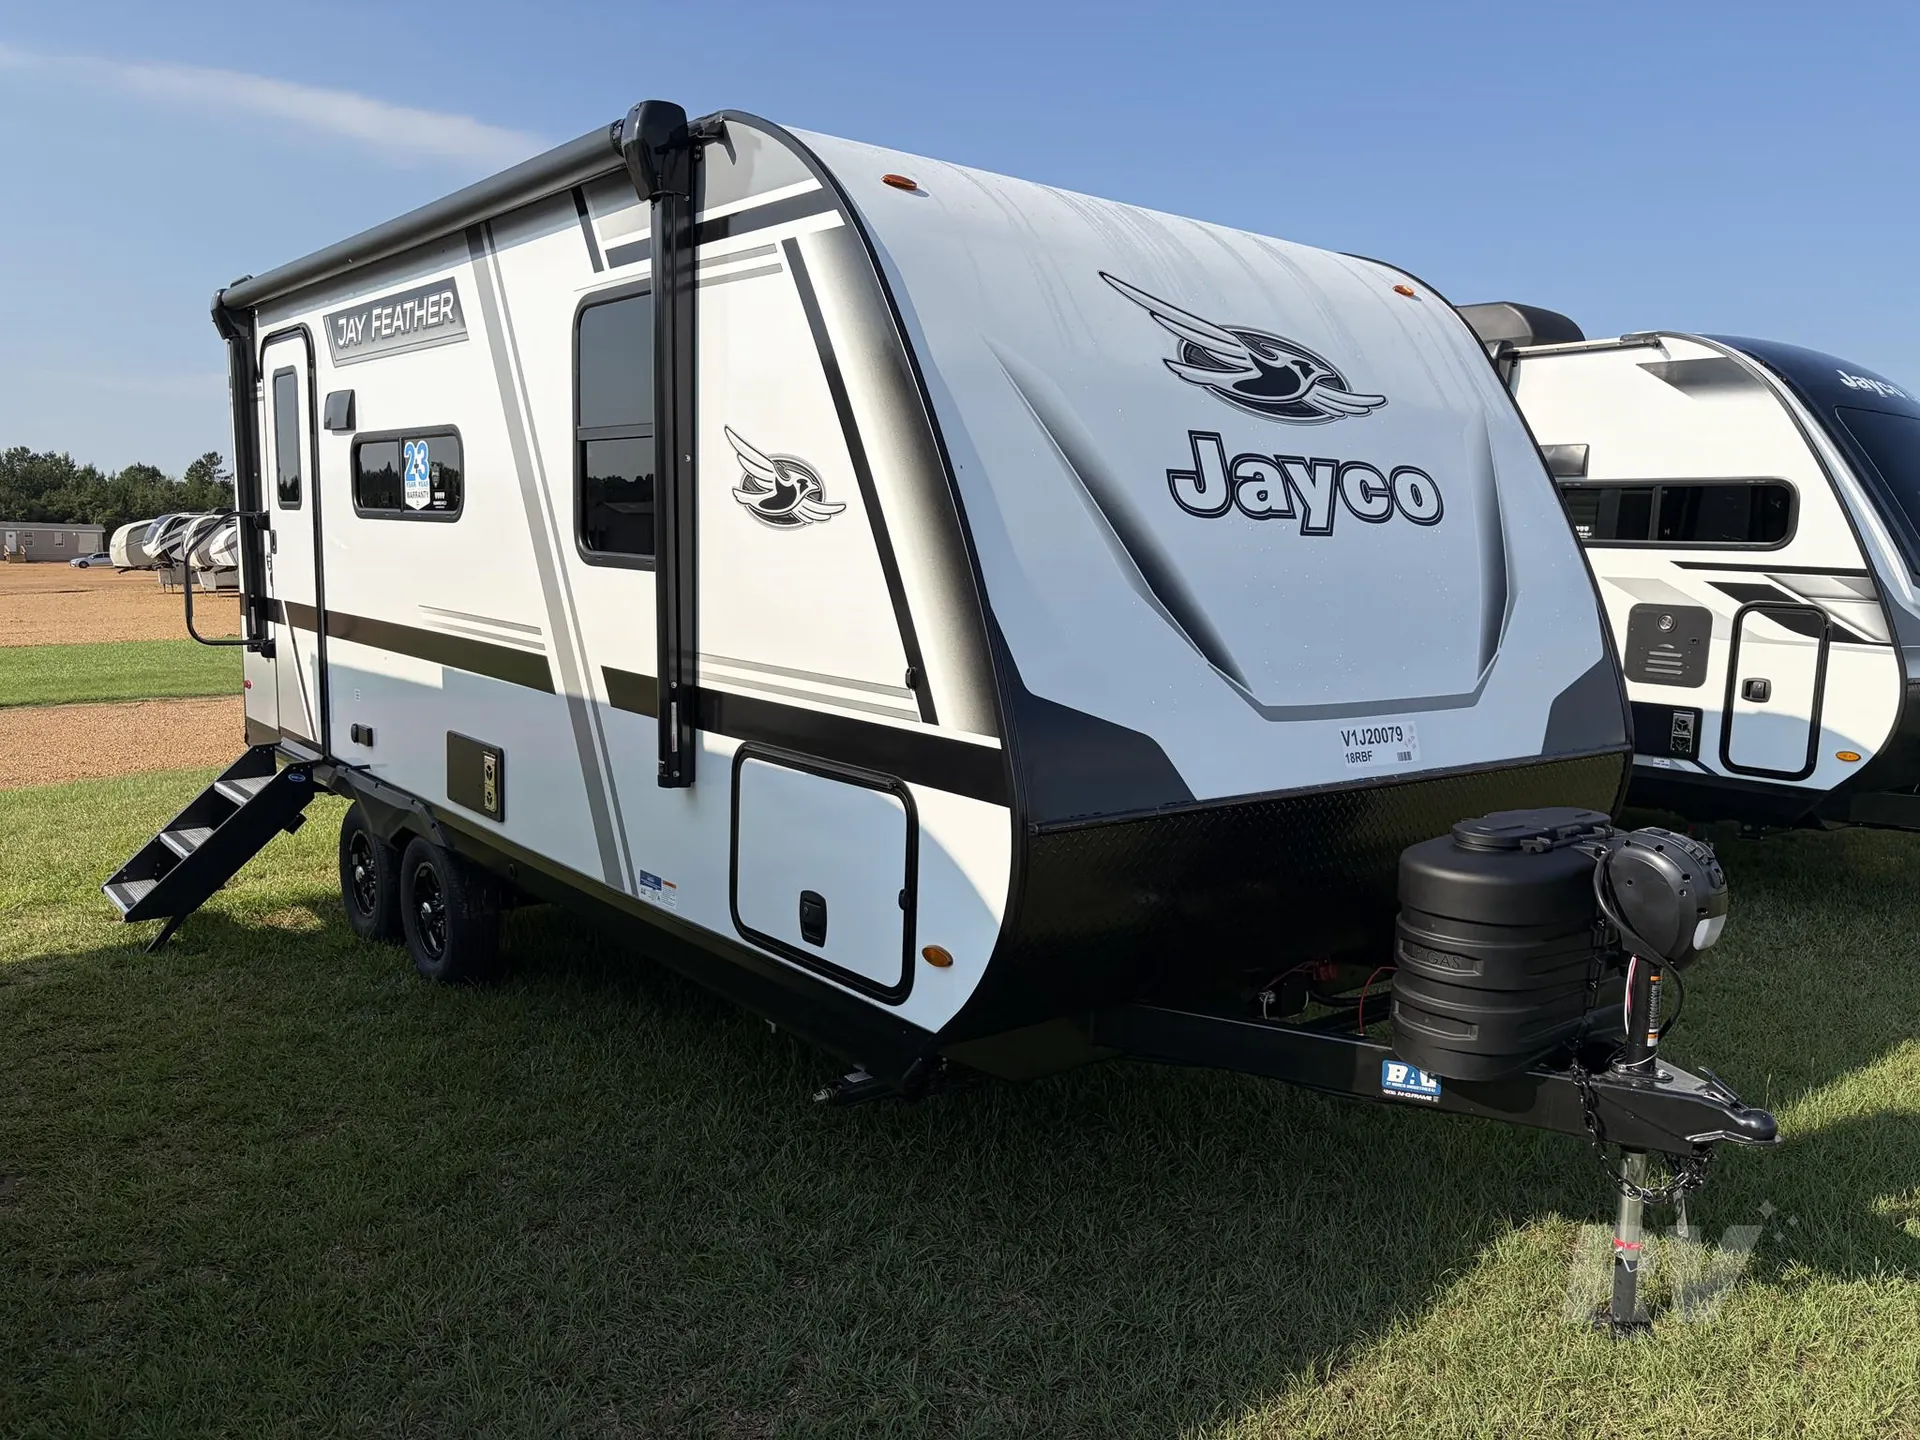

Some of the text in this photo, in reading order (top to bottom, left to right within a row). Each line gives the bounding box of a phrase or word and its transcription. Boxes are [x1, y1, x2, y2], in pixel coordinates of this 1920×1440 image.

[338, 291, 455, 347] JAY FEATHER
[1166, 430, 1444, 536] Jayco
[1341, 726, 1403, 747] V1J20079
[1345, 750, 1373, 763] 18RBF
[1427, 949, 1462, 970] GAS
